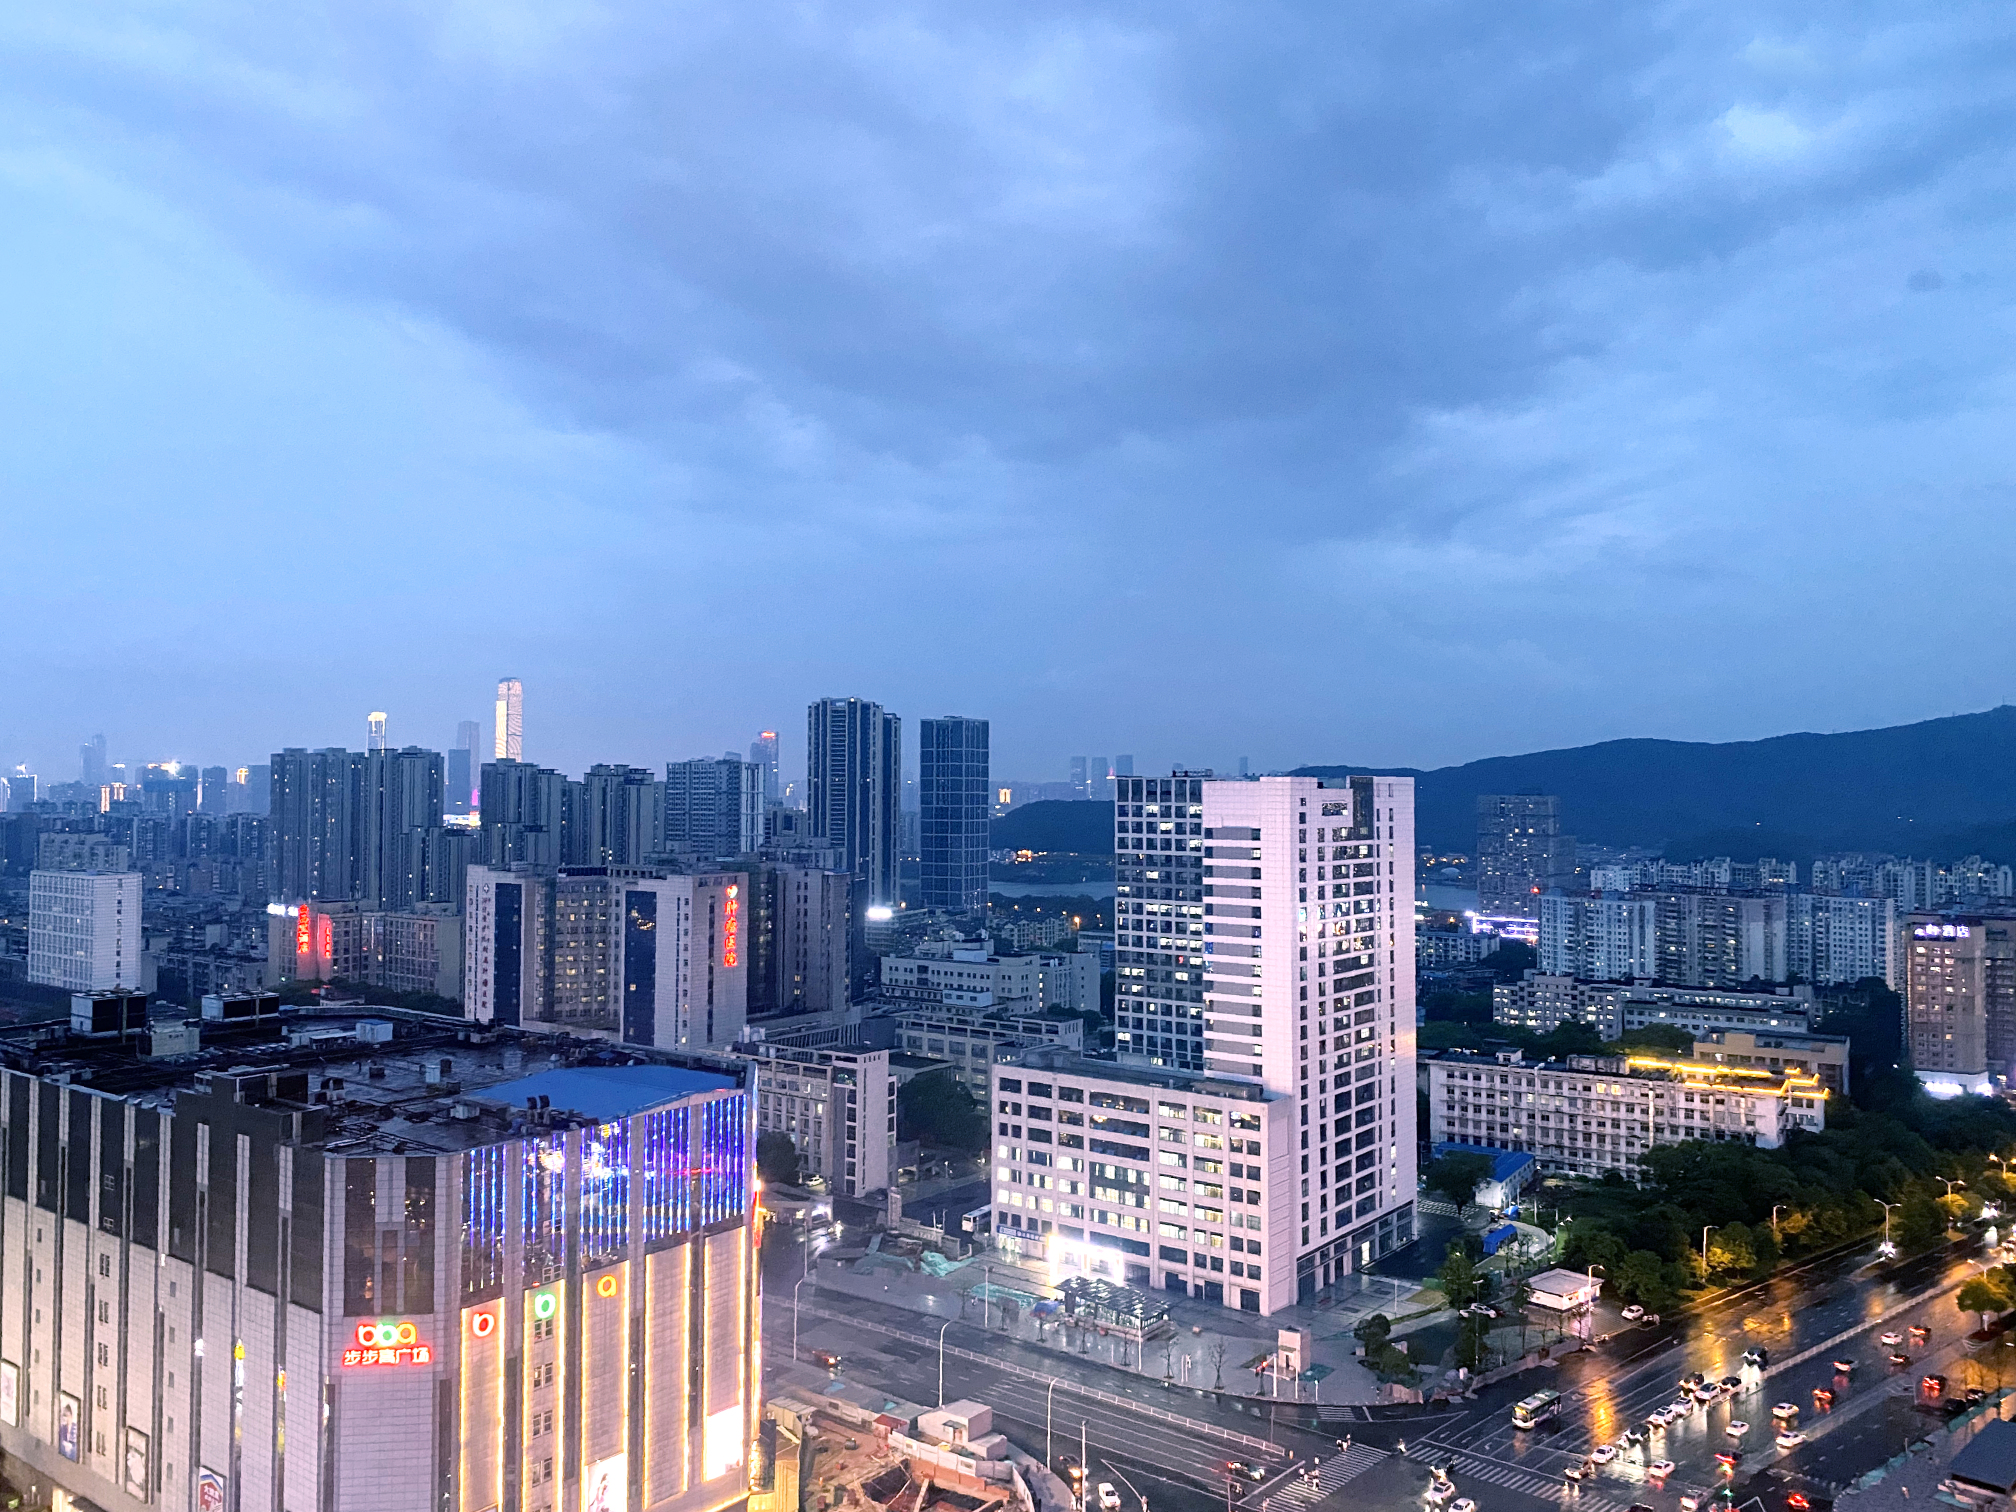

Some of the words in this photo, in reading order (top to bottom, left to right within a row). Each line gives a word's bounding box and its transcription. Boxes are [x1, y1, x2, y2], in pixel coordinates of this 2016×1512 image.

[724, 899, 739, 967] 肿瘤医院
[343, 1347, 430, 1365] 步步高广场
